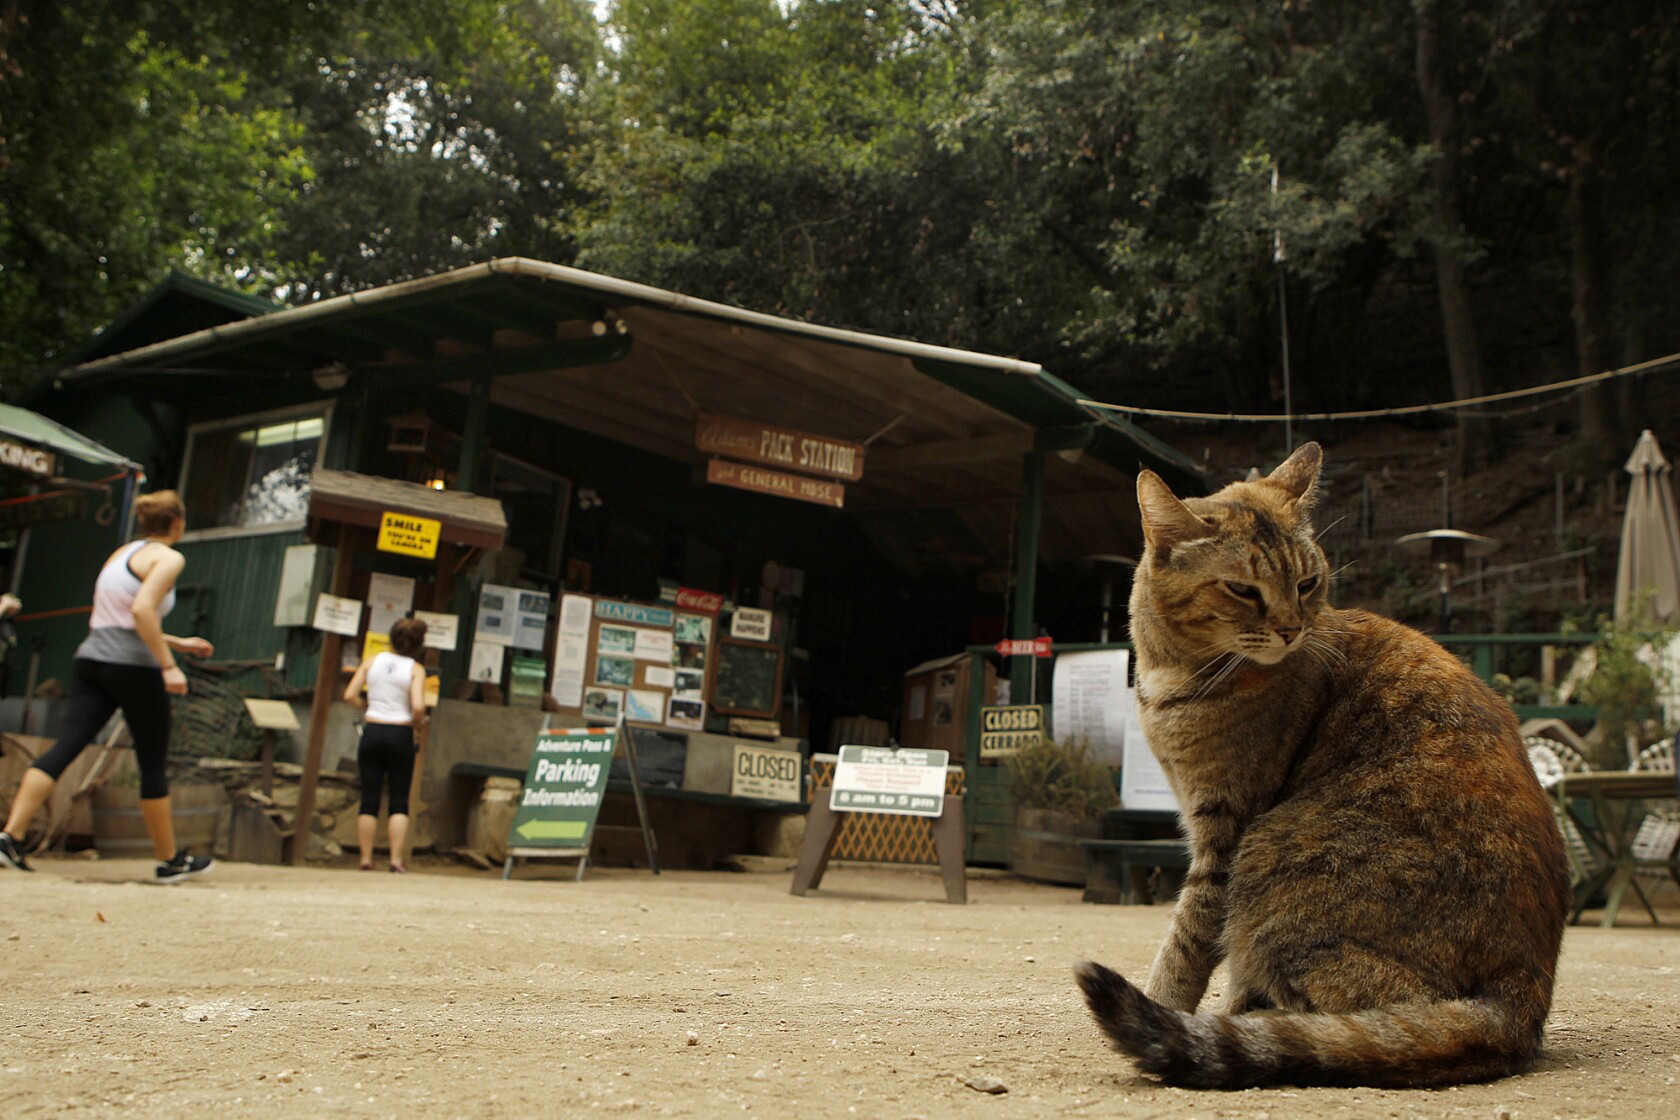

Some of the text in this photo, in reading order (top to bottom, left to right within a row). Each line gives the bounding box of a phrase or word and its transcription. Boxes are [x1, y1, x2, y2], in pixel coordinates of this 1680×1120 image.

[760, 430, 794, 463] PACK
[800, 438, 856, 475] STATION
[740, 469, 795, 492] GENERAL
[386, 517, 423, 532] SMILE
[985, 710, 1038, 730] CLOSED
[536, 738, 582, 753] Adventure
[582, 738, 603, 752] Pass
[534, 758, 601, 788] Parking
[738, 752, 797, 781] CLOSED
[521, 788, 599, 806] Information
[852, 794, 877, 804] am
[879, 794, 896, 805] to
[898, 795, 909, 806] 5
[911, 797, 935, 809] pm
